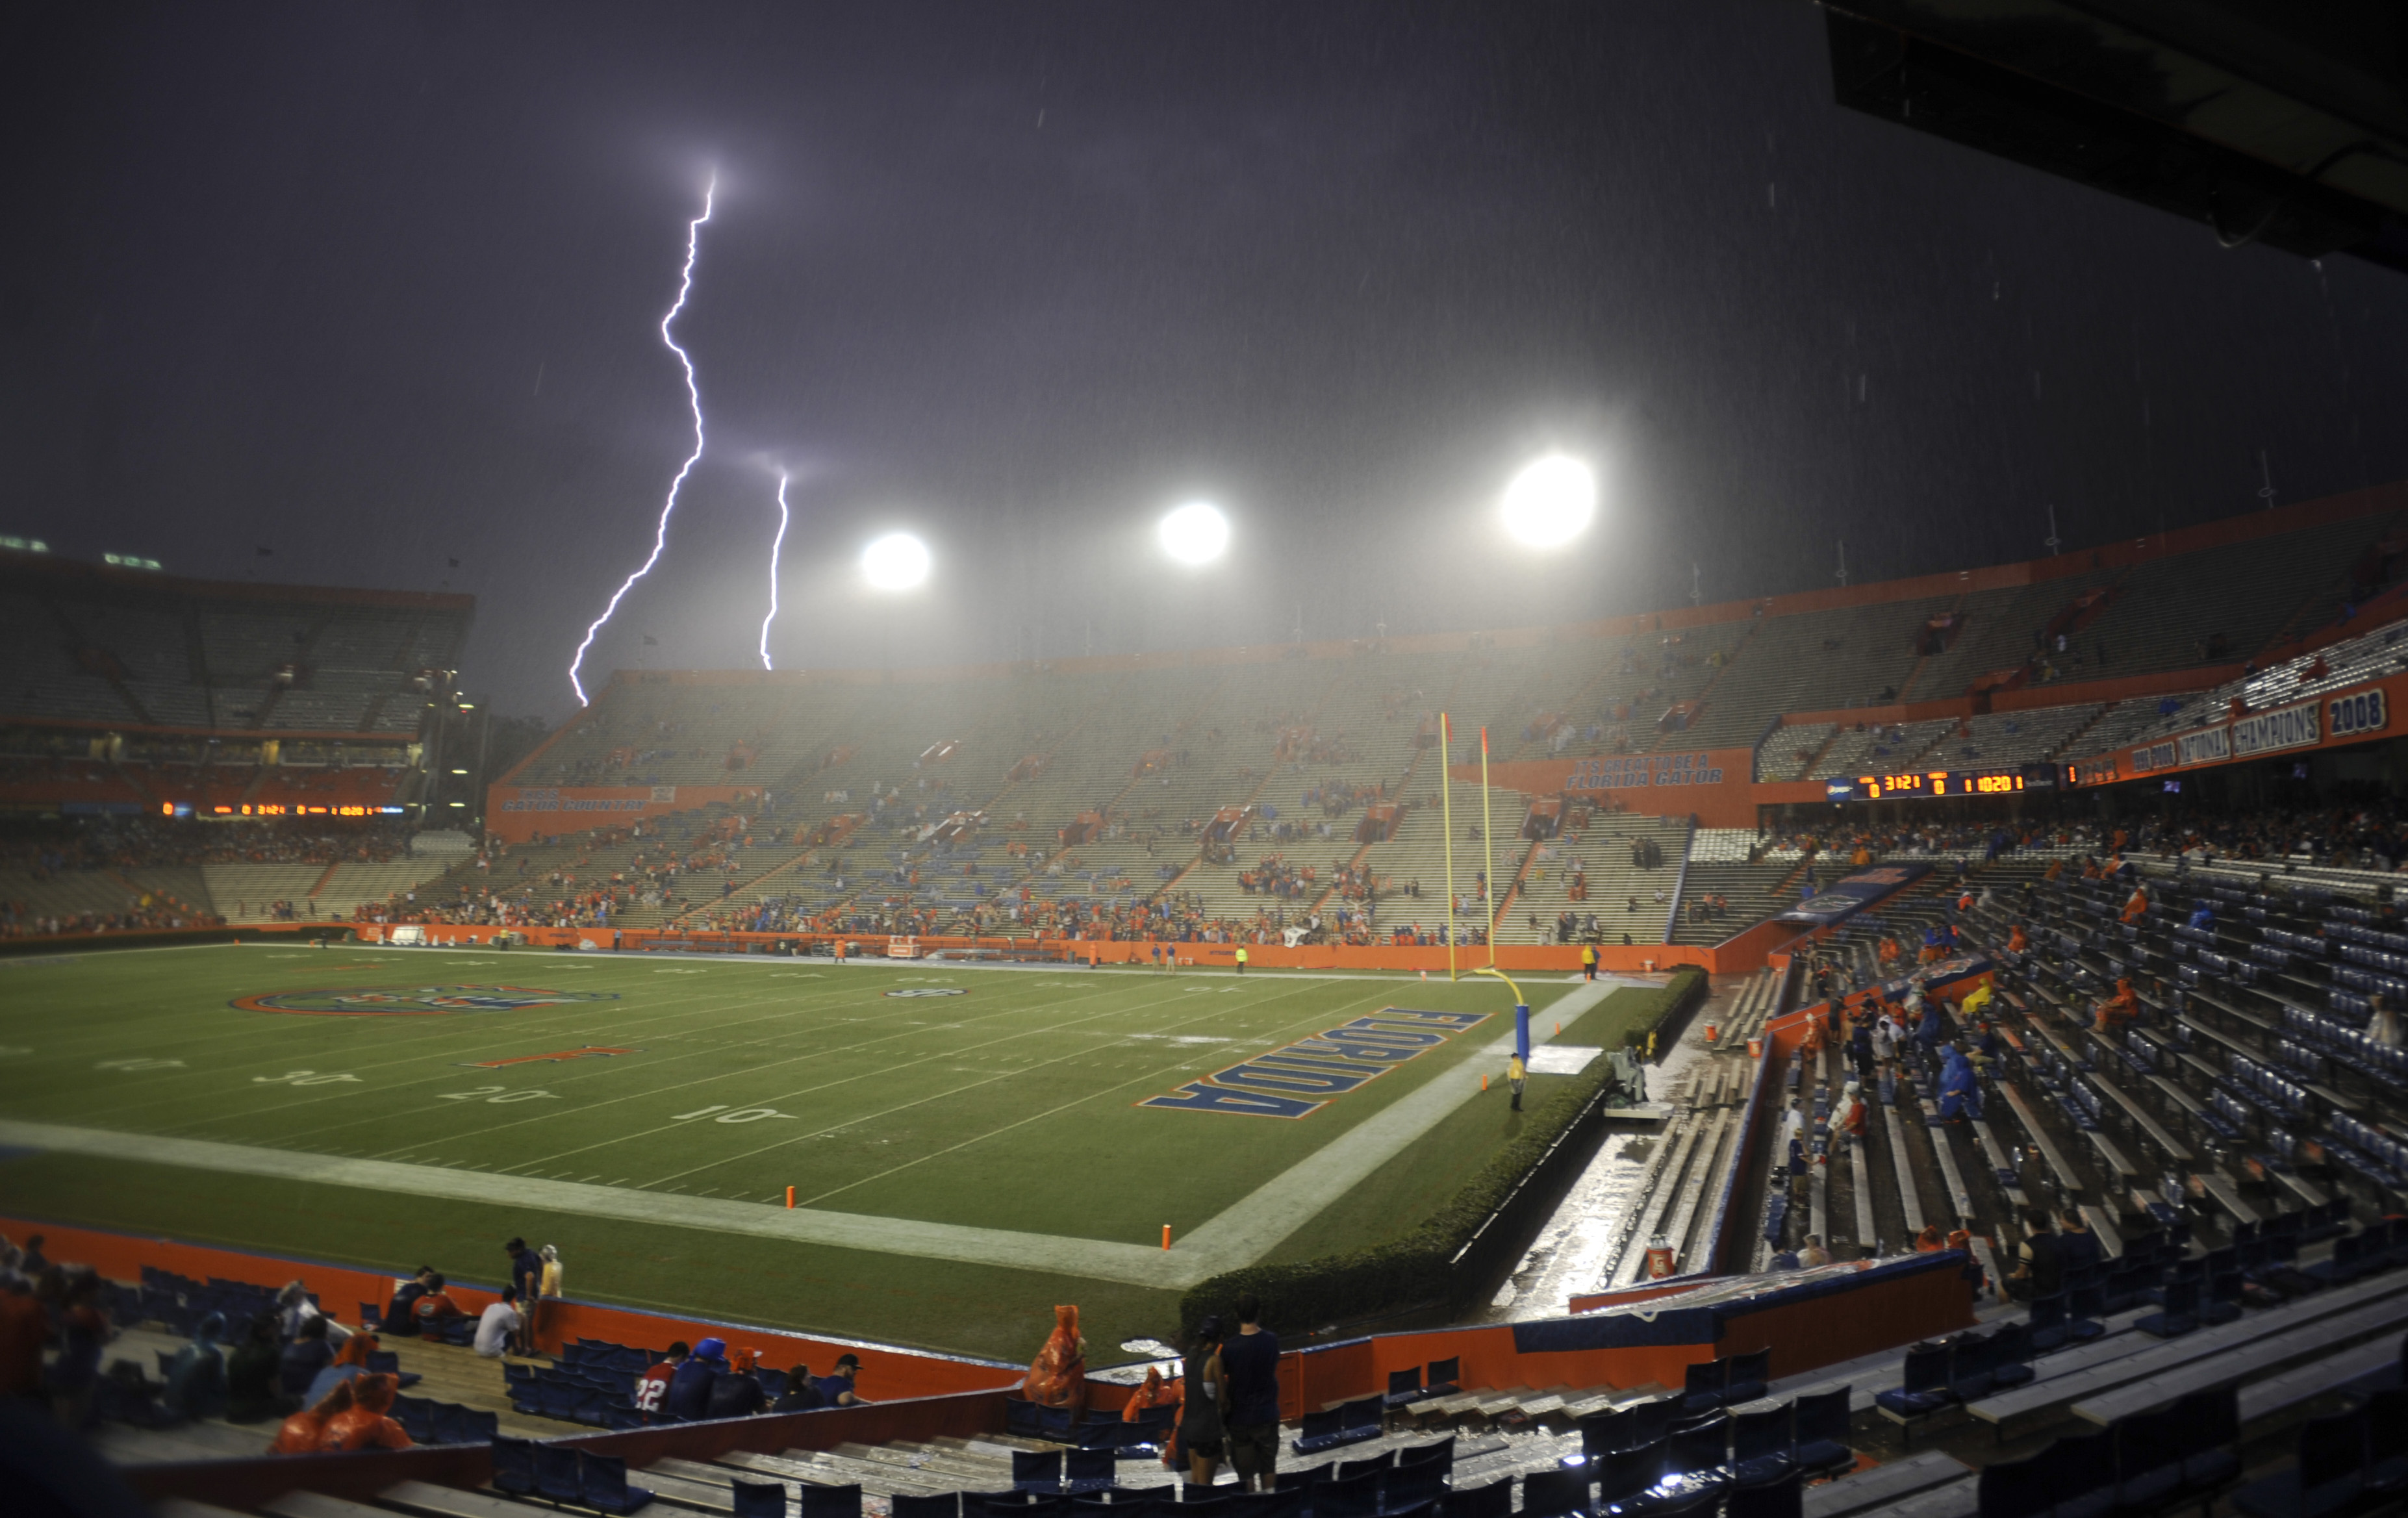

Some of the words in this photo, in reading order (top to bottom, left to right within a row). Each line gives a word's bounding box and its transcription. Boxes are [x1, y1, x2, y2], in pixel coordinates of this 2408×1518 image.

[2234, 703, 2319, 754] CHAMPIONS
[2330, 690, 2384, 735] 2008
[1575, 761, 1600, 774] ITS
[1604, 757, 1651, 772] GREAT
[1654, 756, 1671, 770] TO
[1674, 754, 1694, 770] BE
[1697, 753, 1708, 768] A
[1566, 773, 1648, 790] FLORIDA
[1655, 768, 1723, 786] GATOR
[501, 800, 559, 811] GATOR
[563, 800, 647, 811] COUNTRY
[1134, 1006, 1494, 1119] FLORIDA
[251, 1070, 355, 1085] 30
[435, 1086, 550, 1103] 20
[670, 1105, 778, 1123] 10
